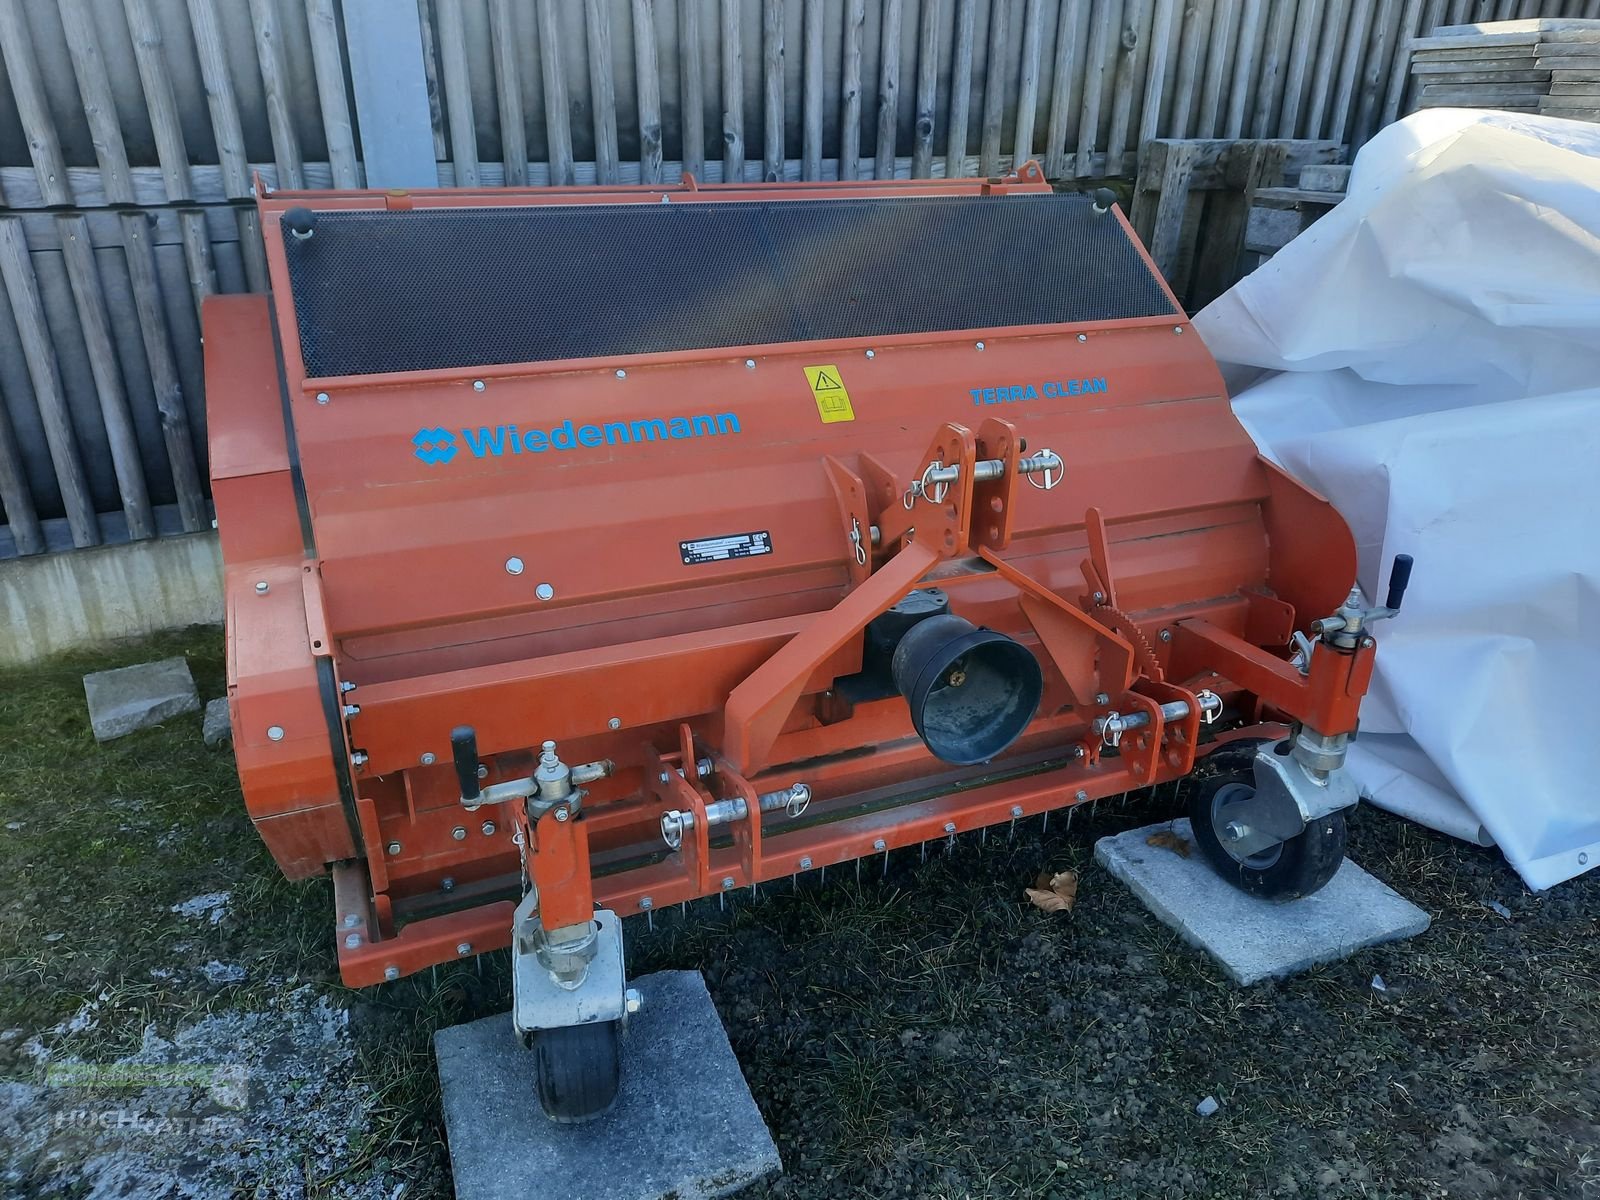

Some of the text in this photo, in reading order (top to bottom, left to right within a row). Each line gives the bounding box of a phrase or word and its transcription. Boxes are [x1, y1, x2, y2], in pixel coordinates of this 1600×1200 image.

[969, 377, 1107, 406] TERRA CLEAN
[460, 412, 741, 458] Wiedenmann
